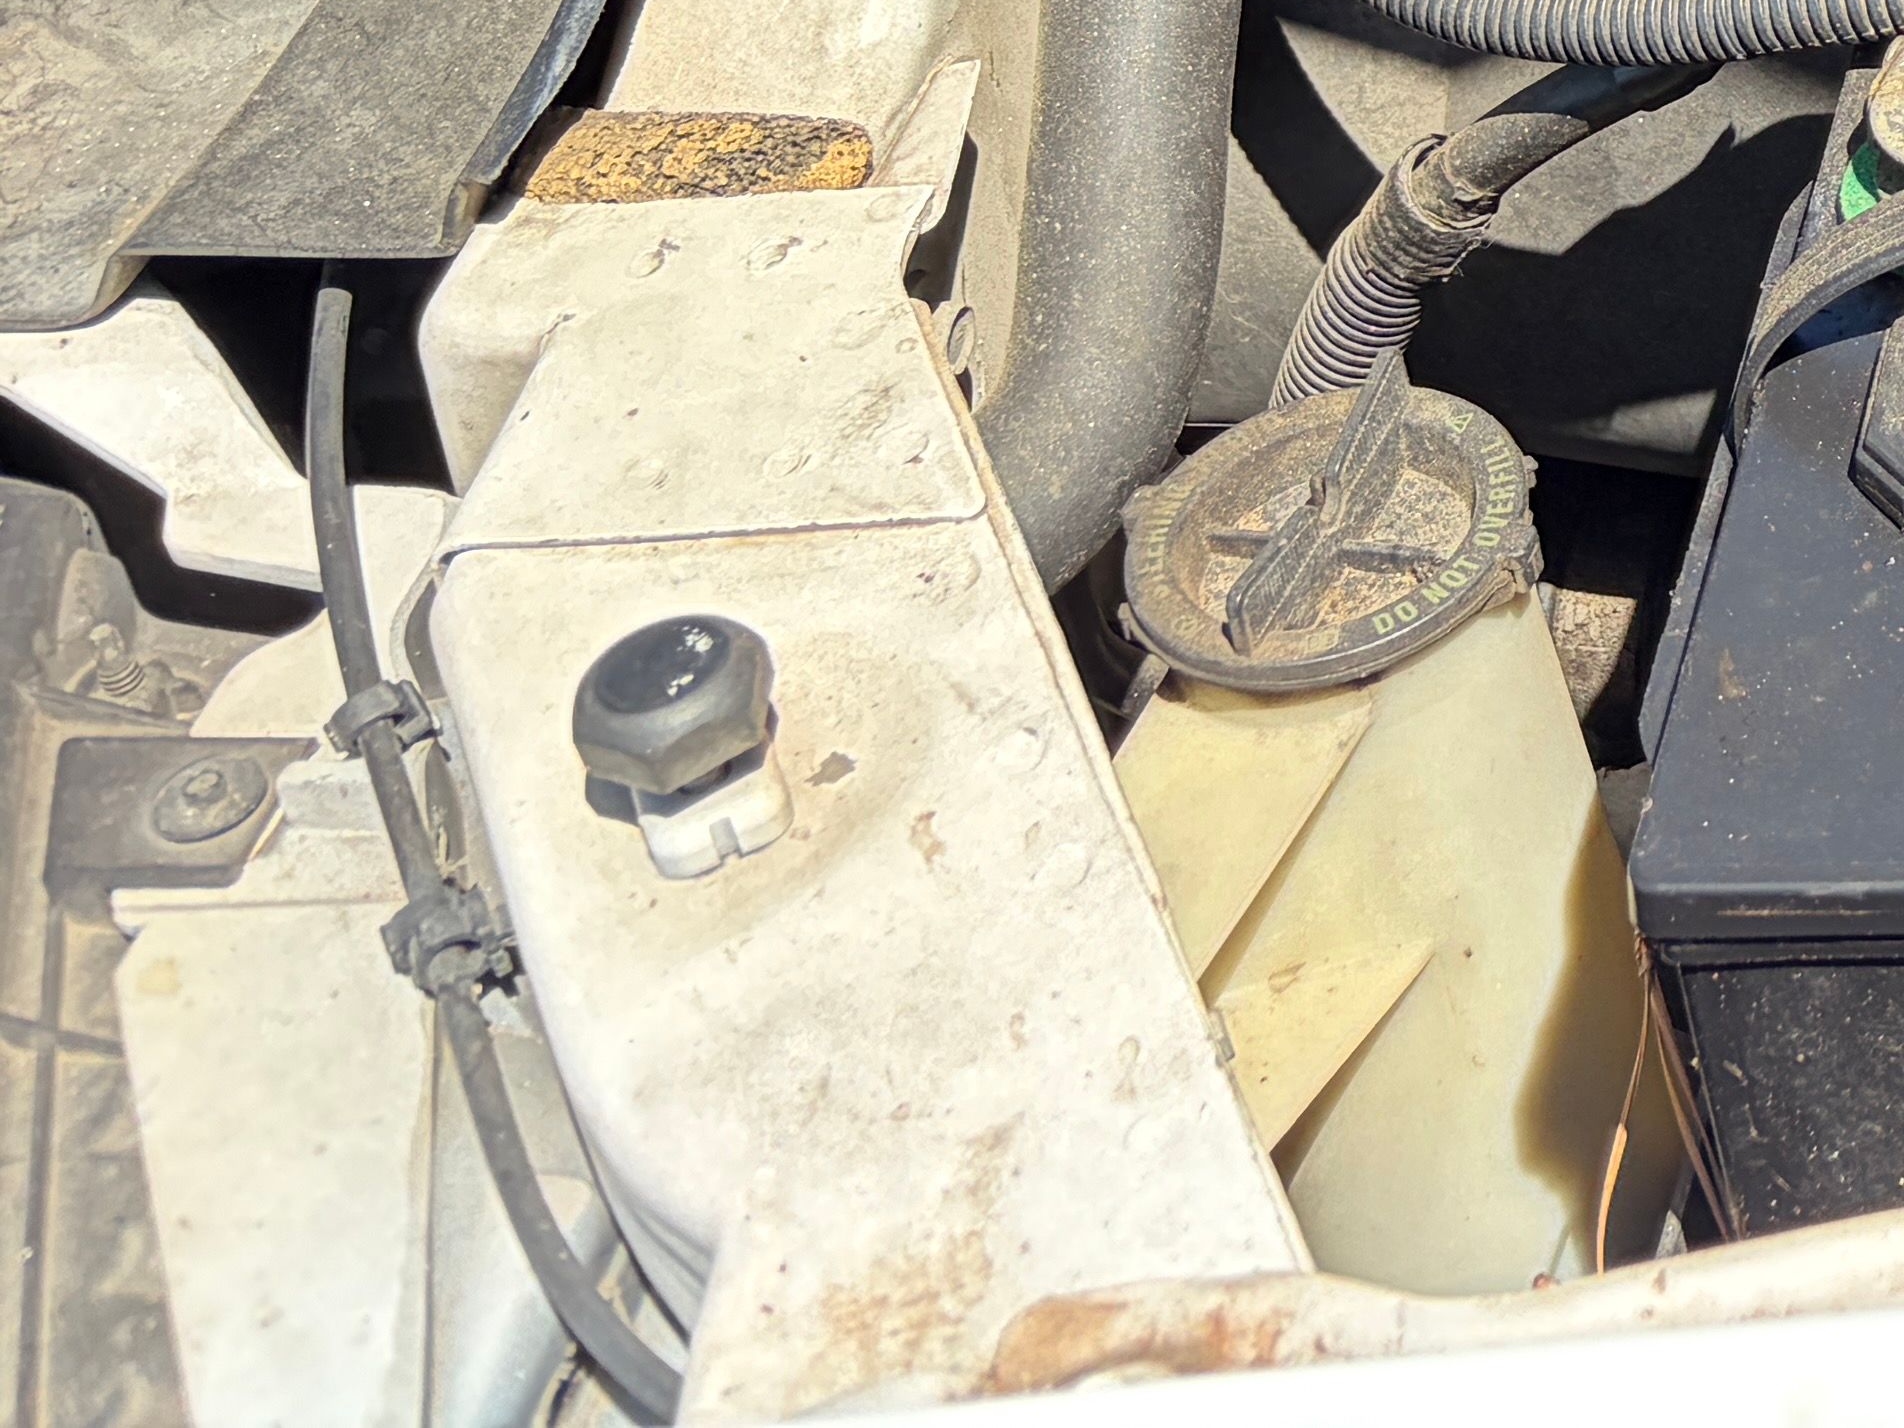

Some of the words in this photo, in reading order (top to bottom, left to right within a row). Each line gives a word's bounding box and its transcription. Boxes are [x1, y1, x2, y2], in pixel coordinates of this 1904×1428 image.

[1372, 601, 1418, 635] DO
[1422, 554, 1480, 604] NOT
[1473, 439, 1519, 548] OVERFILL
